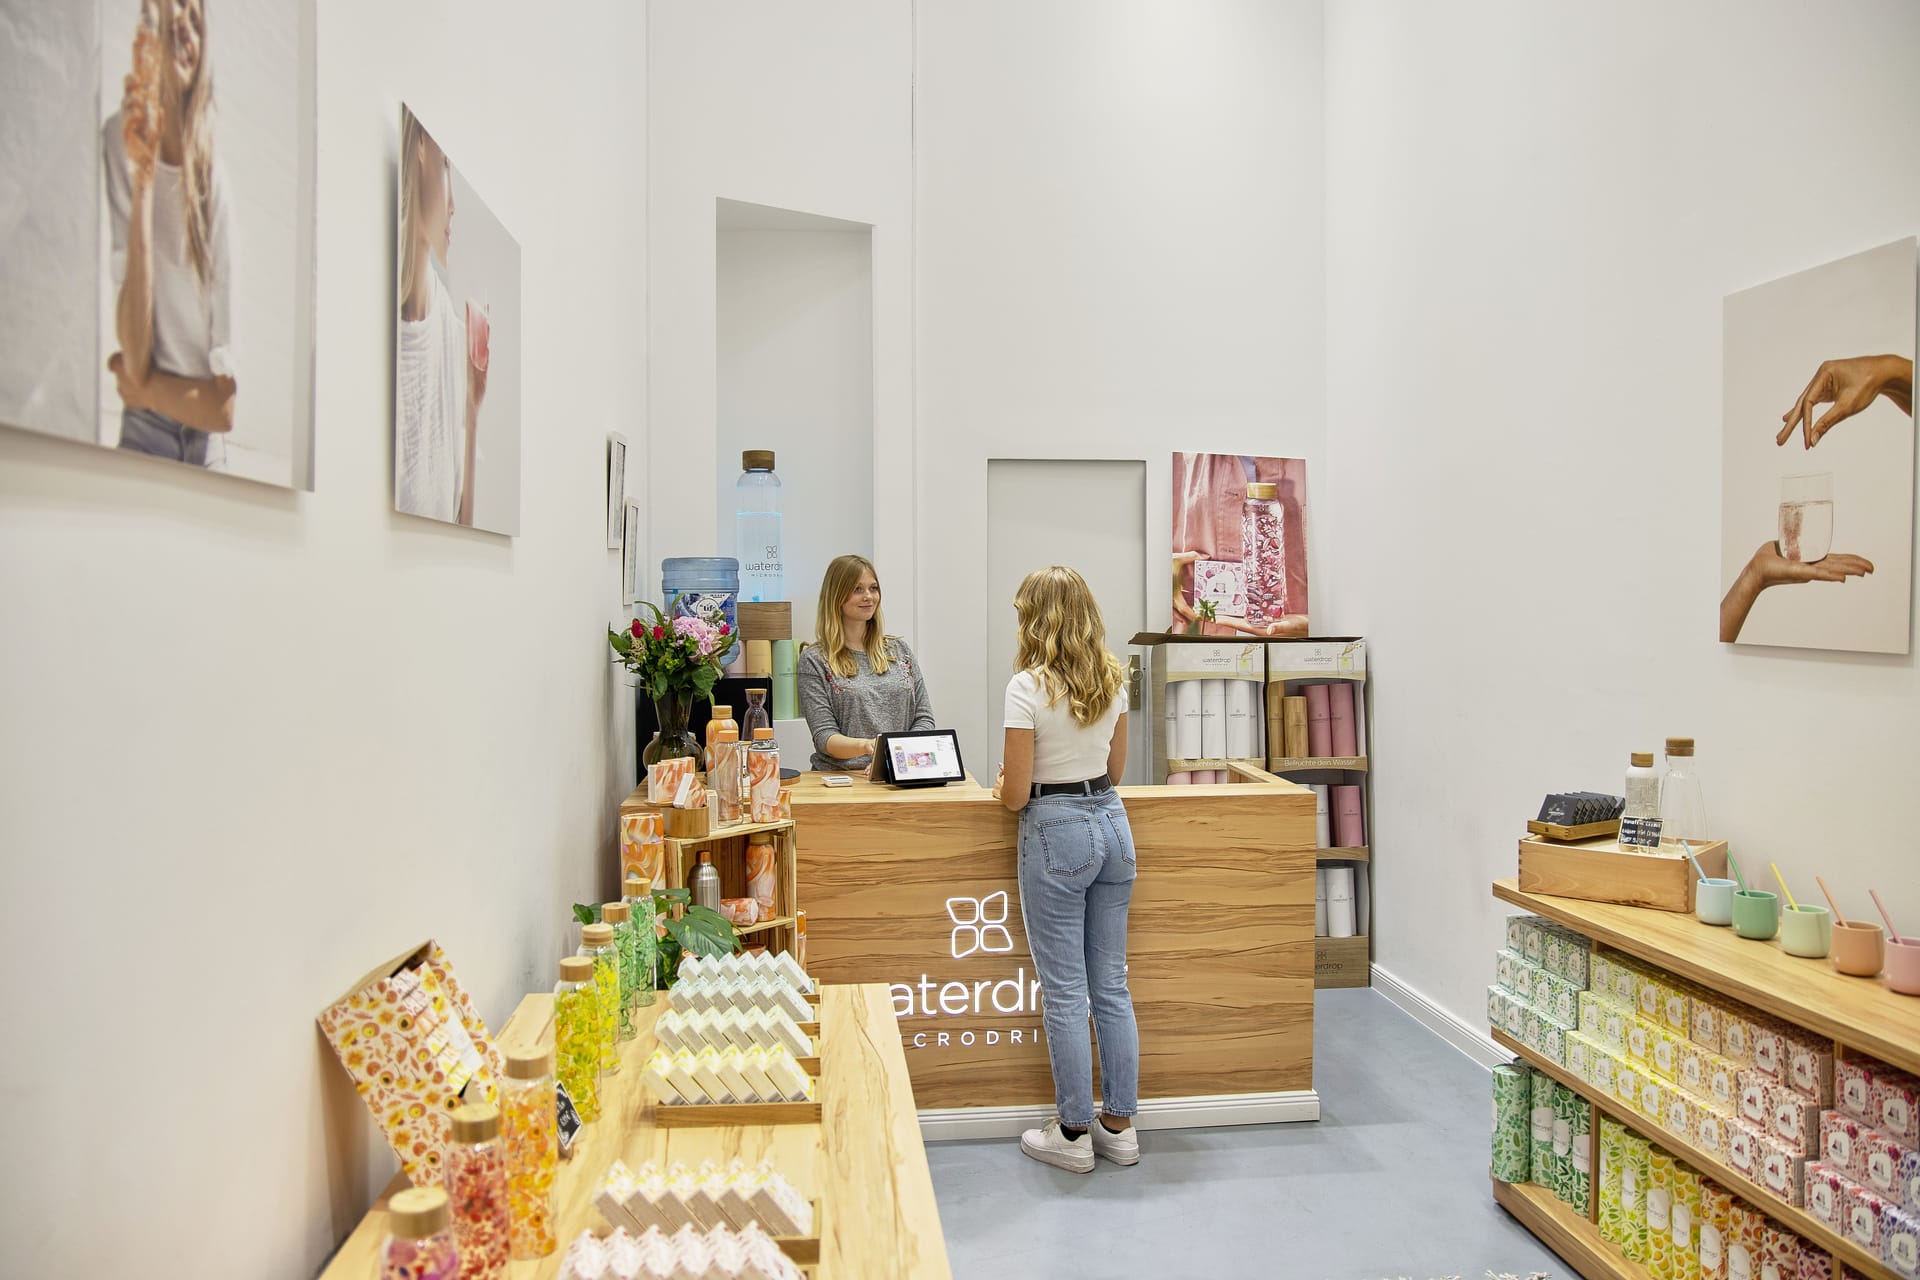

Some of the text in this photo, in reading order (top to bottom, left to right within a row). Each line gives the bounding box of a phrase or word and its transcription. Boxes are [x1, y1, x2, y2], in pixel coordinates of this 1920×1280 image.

[1314, 961, 1343, 971] erdrop
[889, 967, 1043, 1016] aterdr
[912, 1029, 1038, 1048] CRODRI
